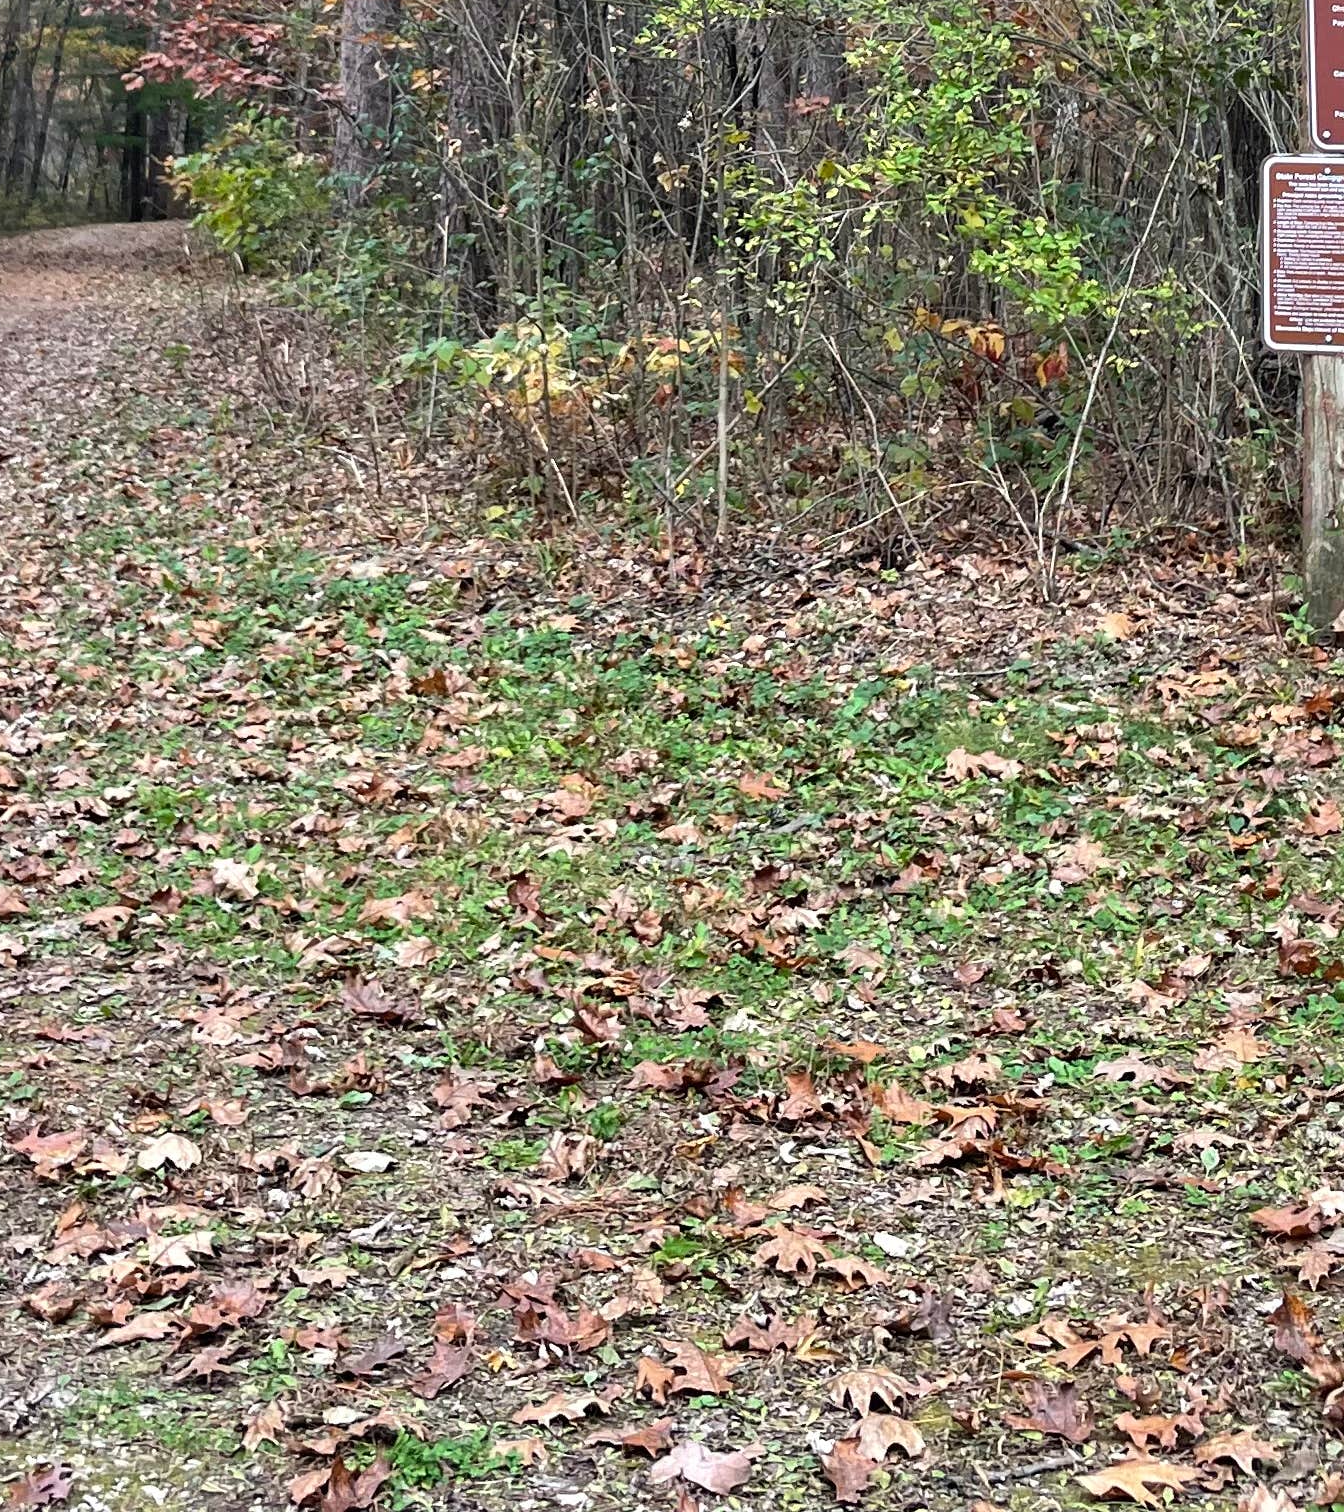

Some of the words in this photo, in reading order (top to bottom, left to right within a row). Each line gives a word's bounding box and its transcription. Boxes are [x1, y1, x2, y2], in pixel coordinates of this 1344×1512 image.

[1332, 19, 1344, 28] Pay
[1276, 172, 1293, 181] State
[1294, 172, 1316, 181] Forest
